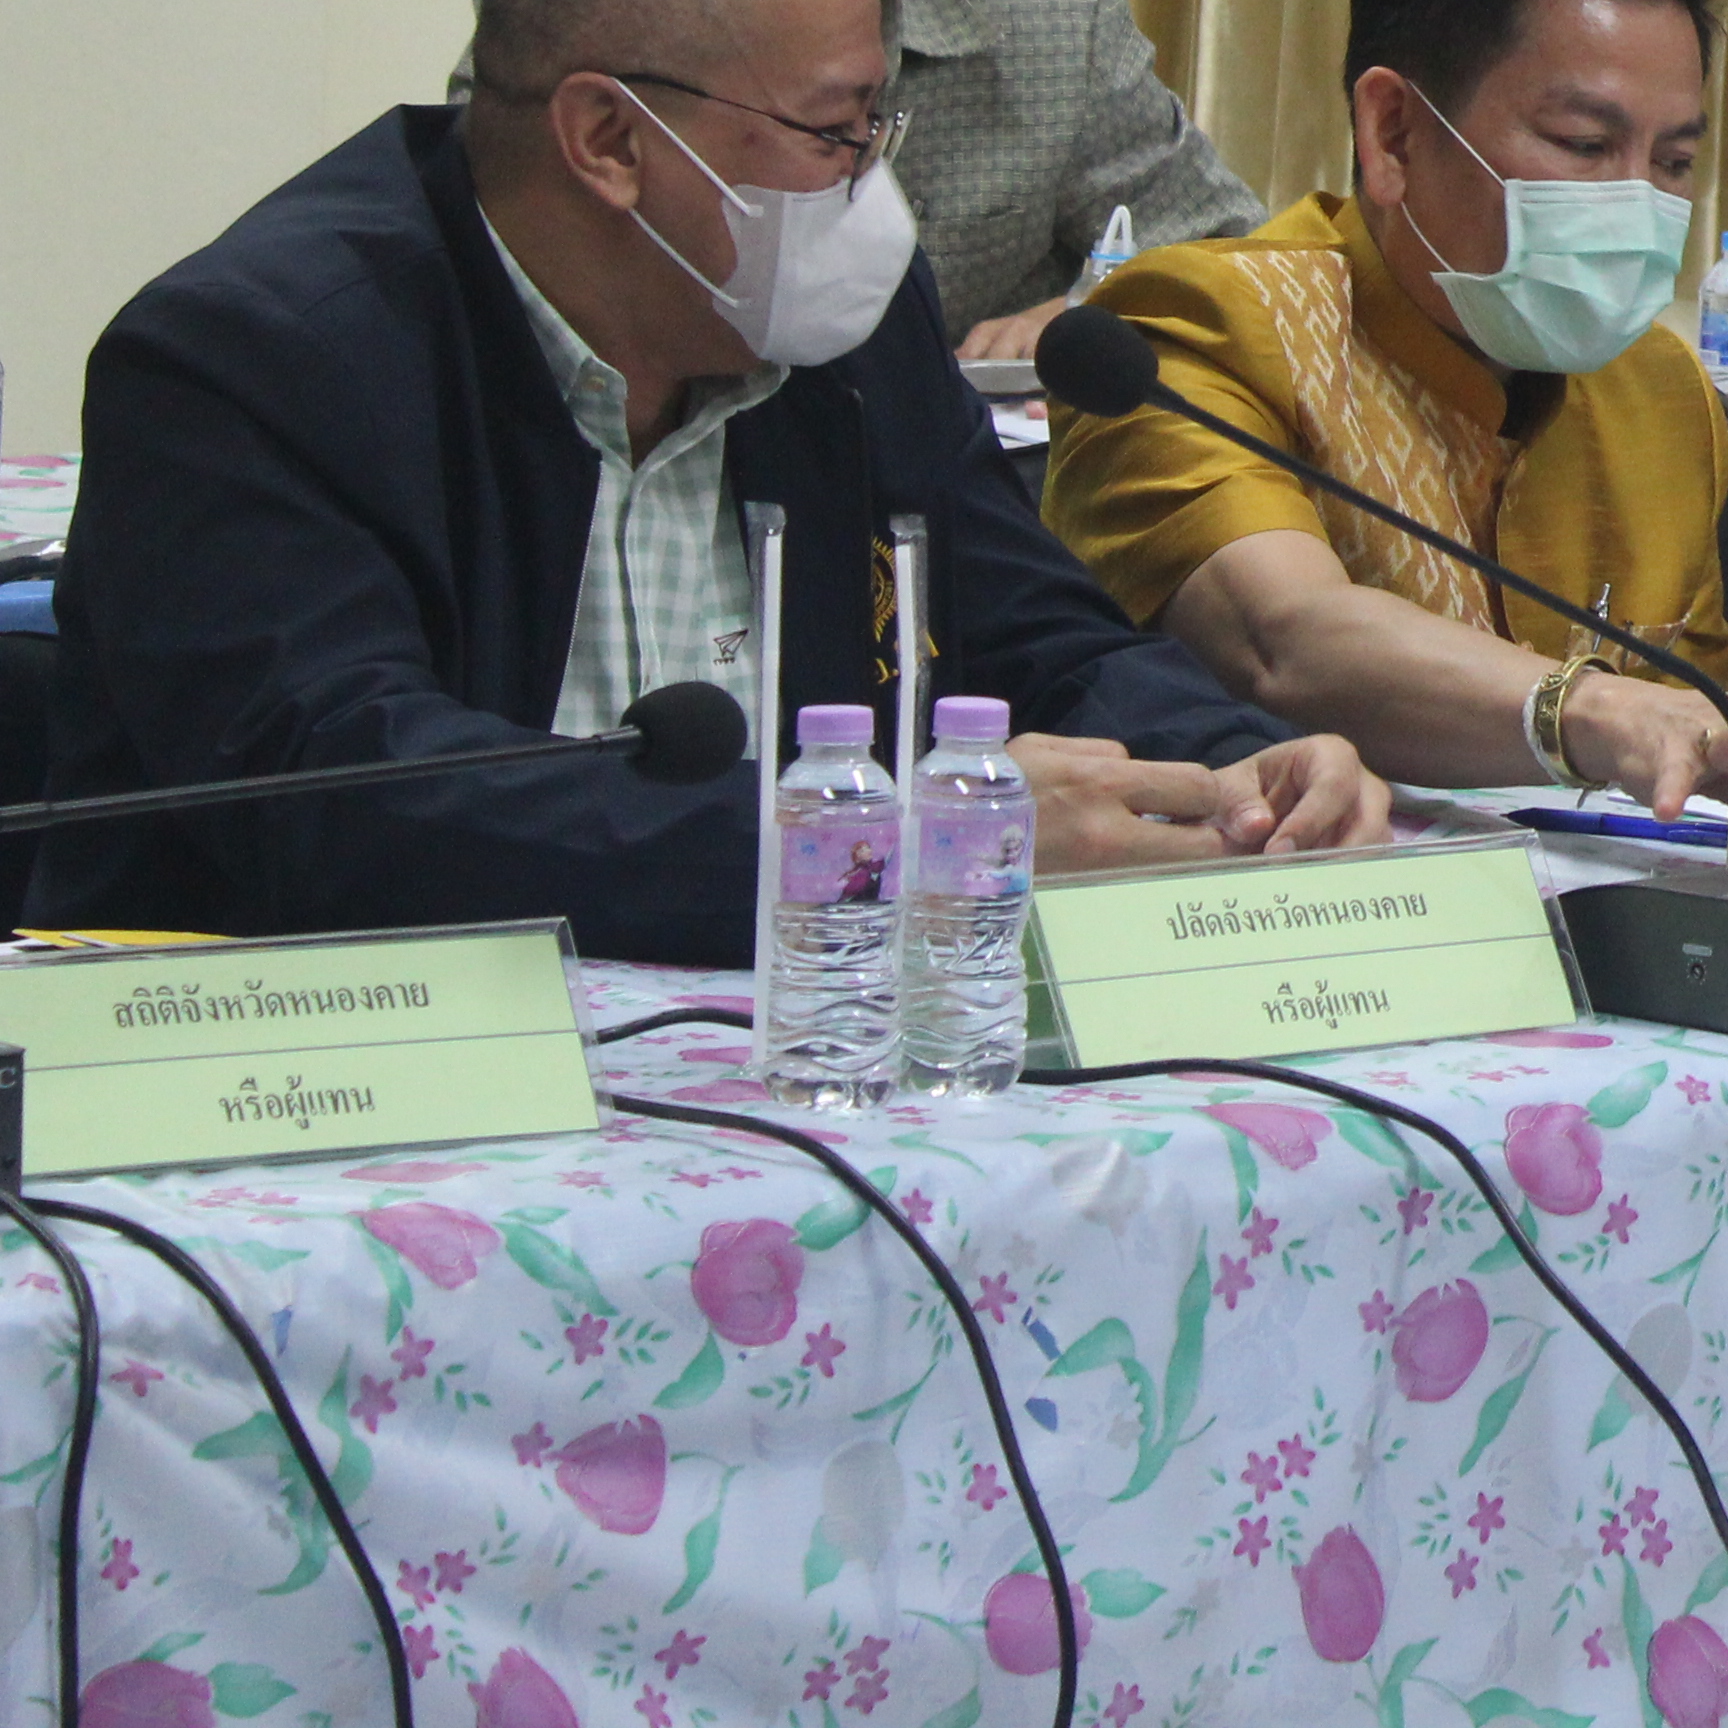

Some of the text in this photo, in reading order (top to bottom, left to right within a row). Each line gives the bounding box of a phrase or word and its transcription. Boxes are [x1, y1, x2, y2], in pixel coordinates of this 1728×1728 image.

[1166, 891, 1428, 942] ปลัดจังหวัดหนองคาย
[112, 979, 429, 1028] สถิติจังหวัดหนองคาย
[1261, 979, 1390, 1030] หรือผู้แทน
[218, 1074, 376, 1130] หรือผู้แทน
